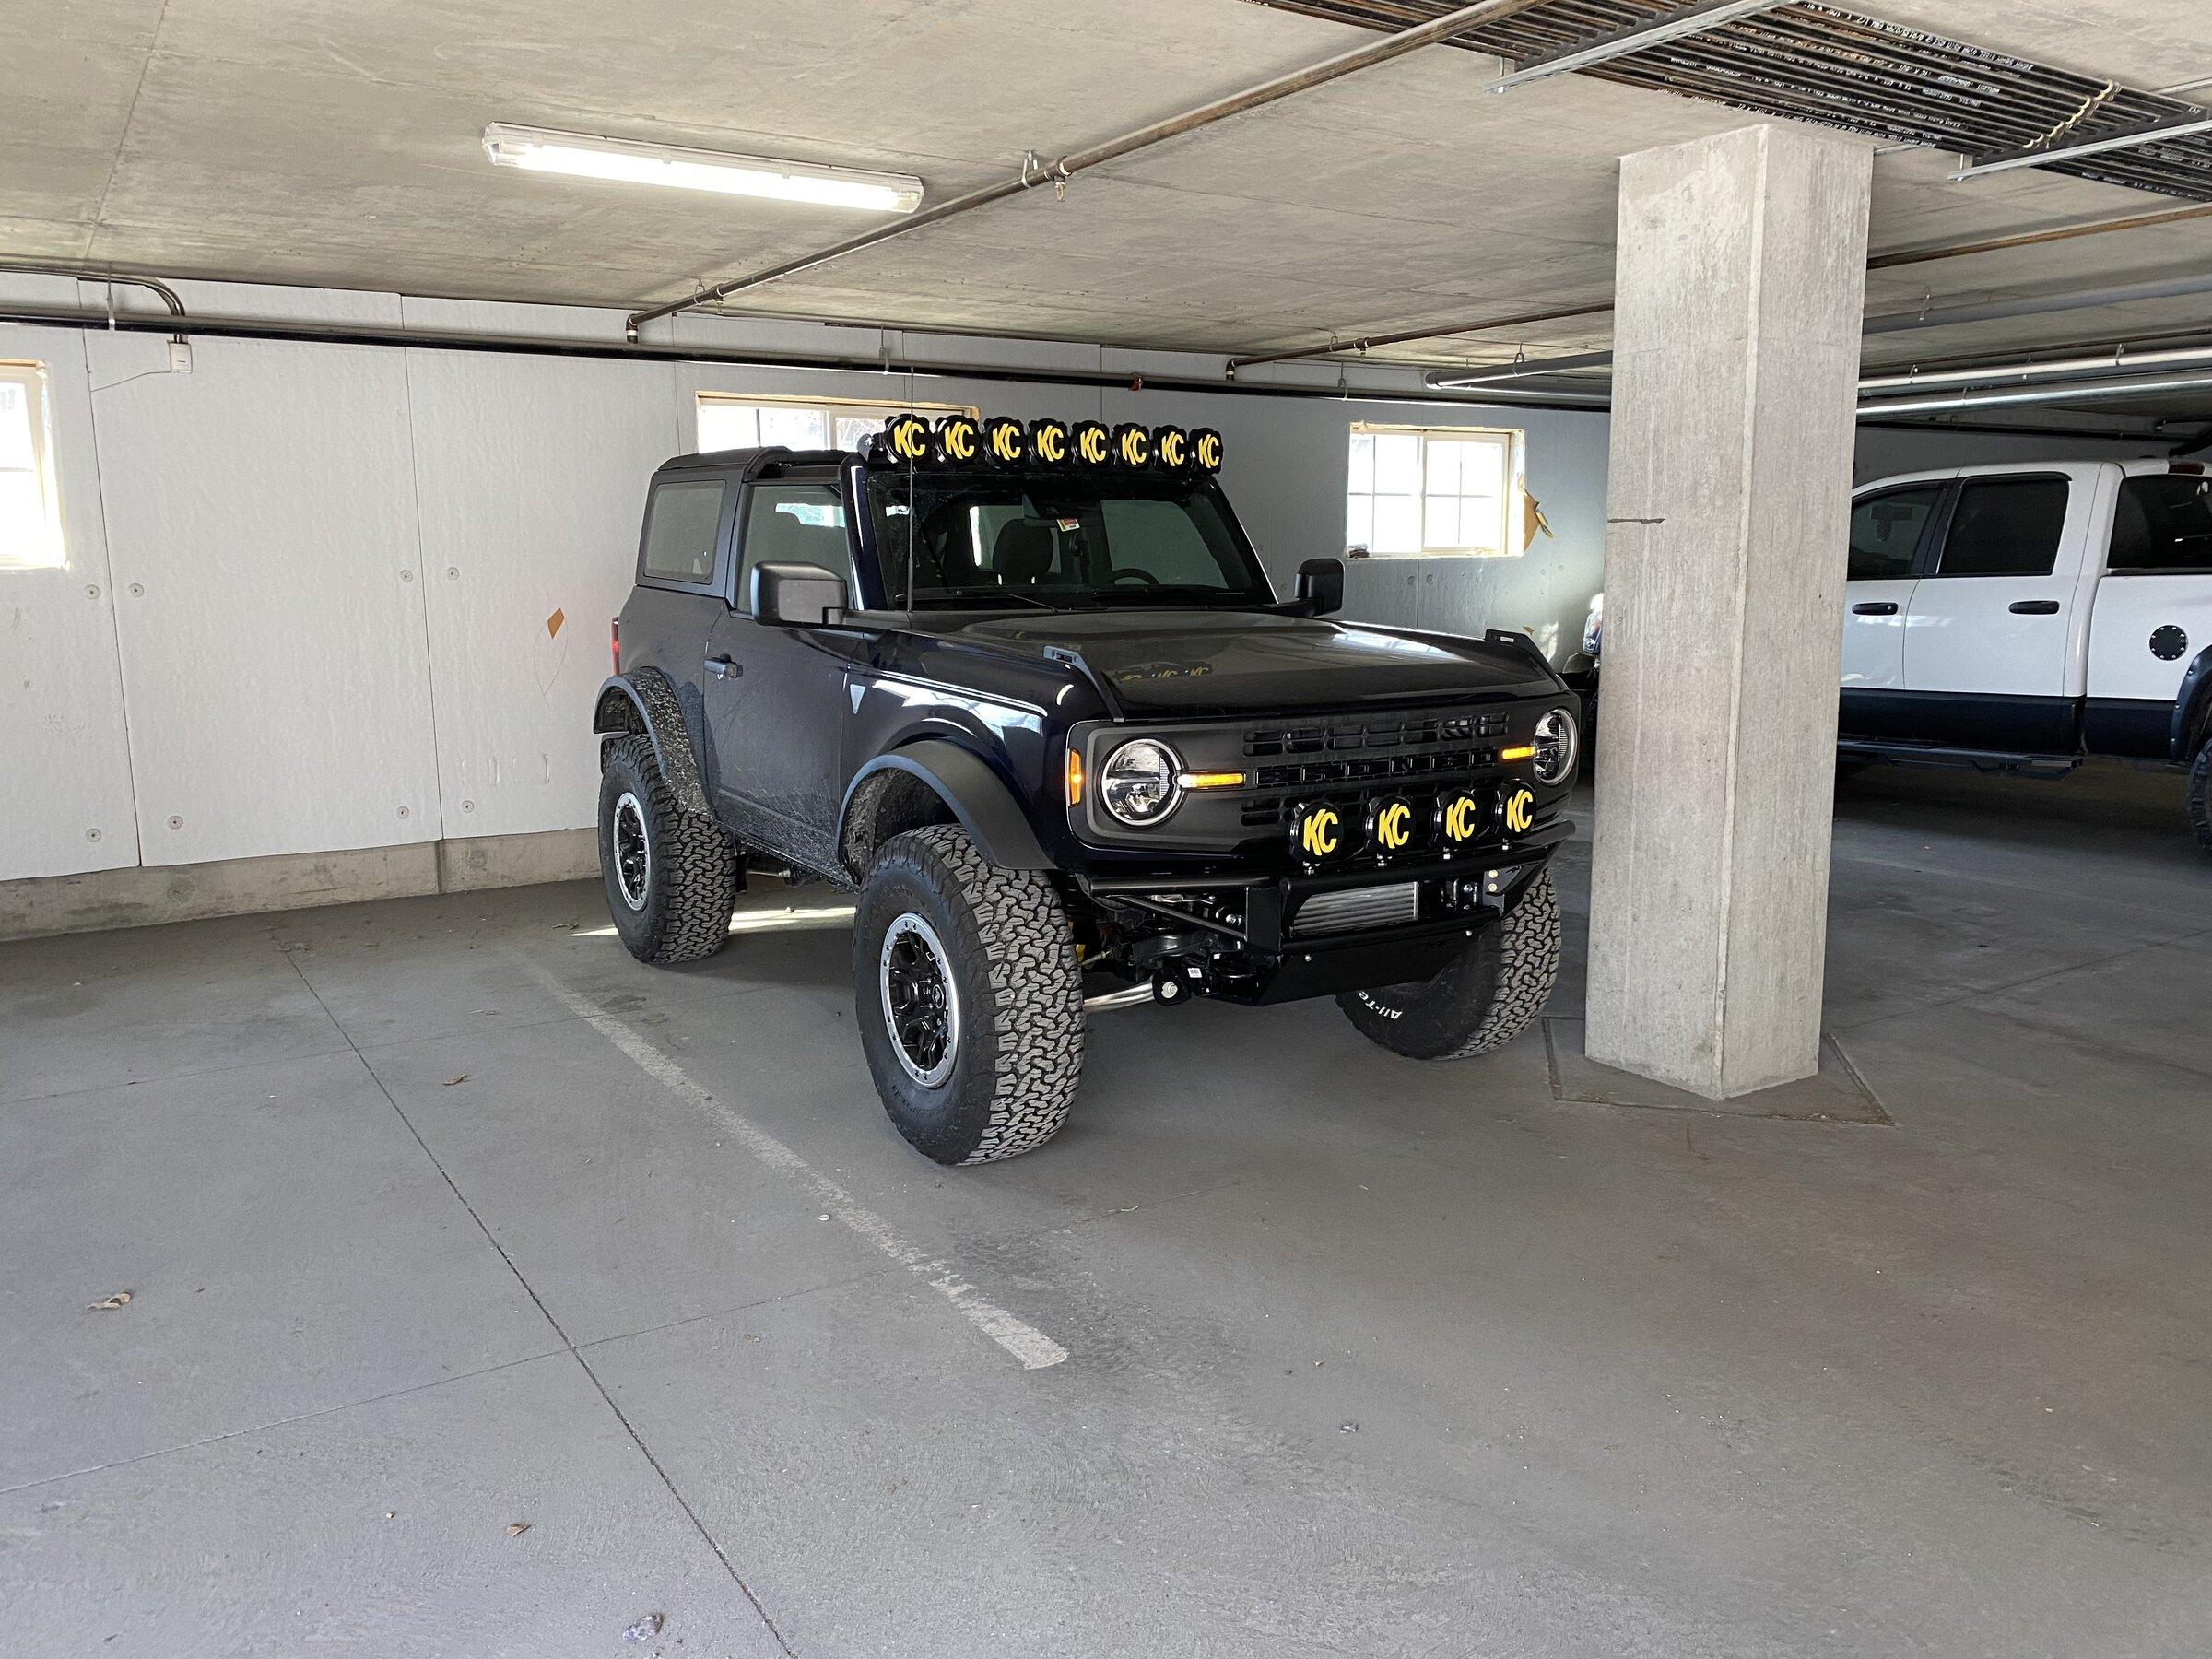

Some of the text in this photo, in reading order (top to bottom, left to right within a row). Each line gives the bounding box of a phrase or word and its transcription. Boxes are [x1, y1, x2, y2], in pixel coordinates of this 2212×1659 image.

[894, 420, 925, 459] KC
[944, 421, 974, 460] KC
[992, 423, 1021, 461] KC
[1037, 425, 1065, 461] KC
[1080, 427, 1106, 464] KC
[1122, 429, 1147, 465] KC
[1161, 431, 1184, 466] KC
[1198, 434, 1219, 468] KC
[1378, 803, 1411, 849] KC
[1445, 797, 1476, 841] KC
[1507, 789, 1533, 832] KC
[1302, 809, 1338, 856] KC
